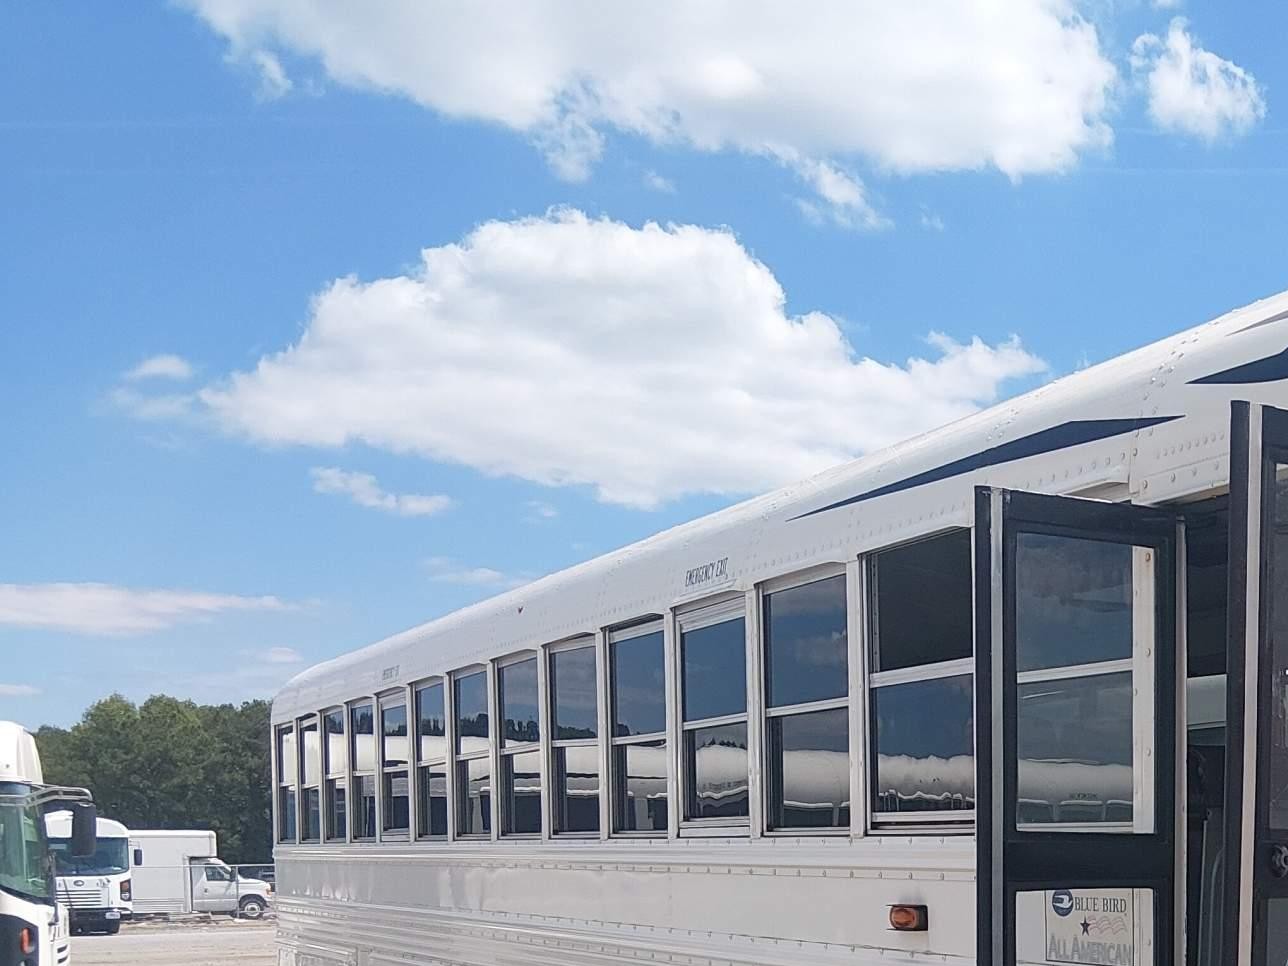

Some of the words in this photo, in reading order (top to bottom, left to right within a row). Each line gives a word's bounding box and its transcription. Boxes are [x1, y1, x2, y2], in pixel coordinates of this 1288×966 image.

[685, 562, 715, 587] EMERGENCY
[716, 557, 728, 577] EXIT
[1074, 896, 1099, 912] BLUE
[1102, 898, 1127, 913] BIRD
